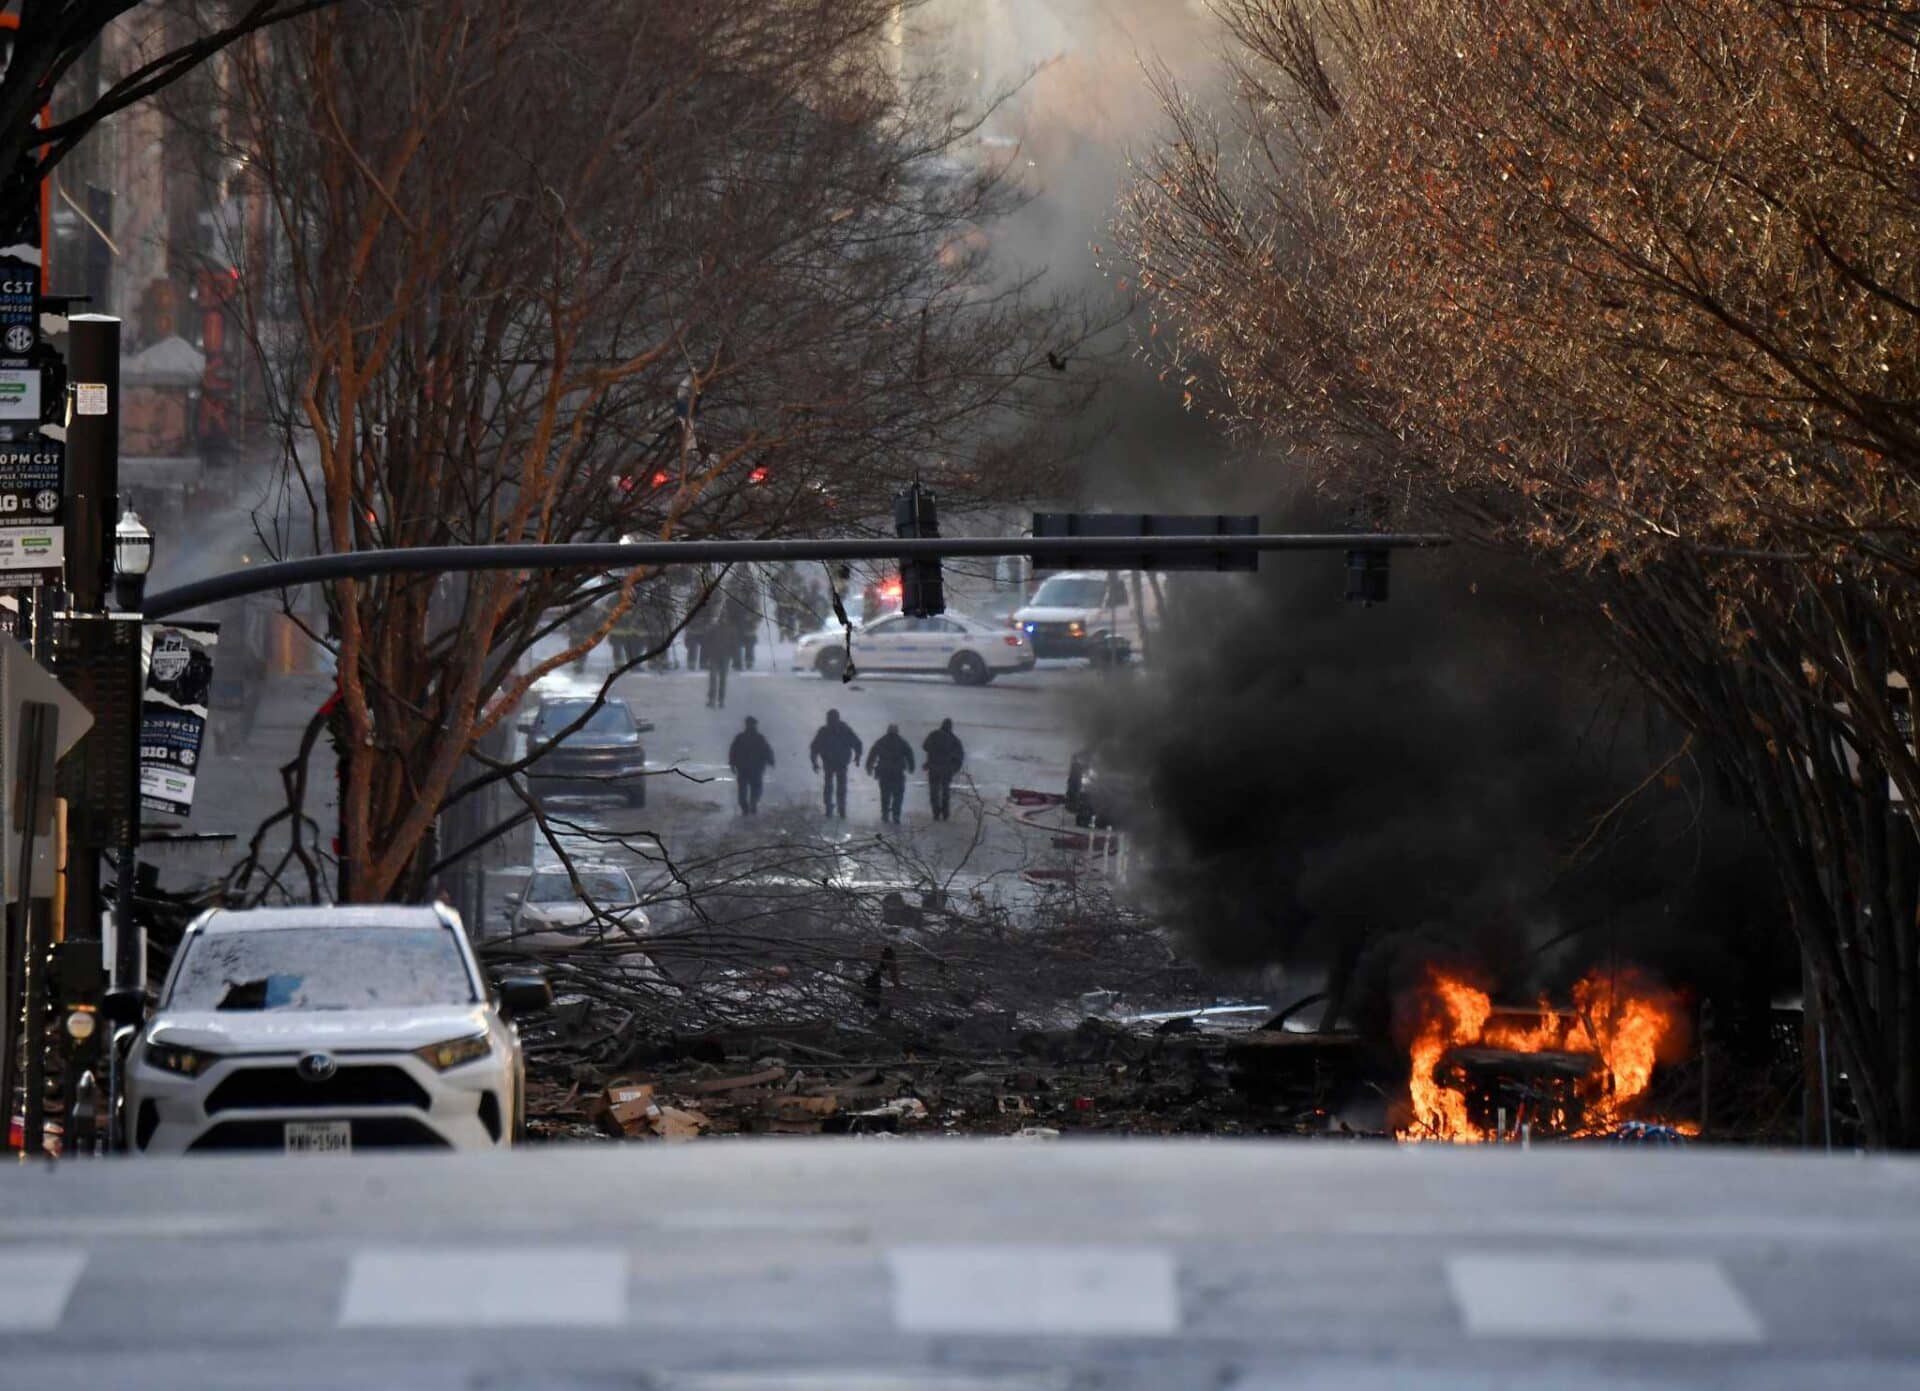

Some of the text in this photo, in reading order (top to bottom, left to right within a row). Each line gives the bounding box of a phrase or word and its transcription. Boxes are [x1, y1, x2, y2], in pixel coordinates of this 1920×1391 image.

[2, 281, 33, 294] CST
[10, 454, 30, 465] PM
[33, 454, 59, 465] CST
[182, 723, 200, 733] CST
